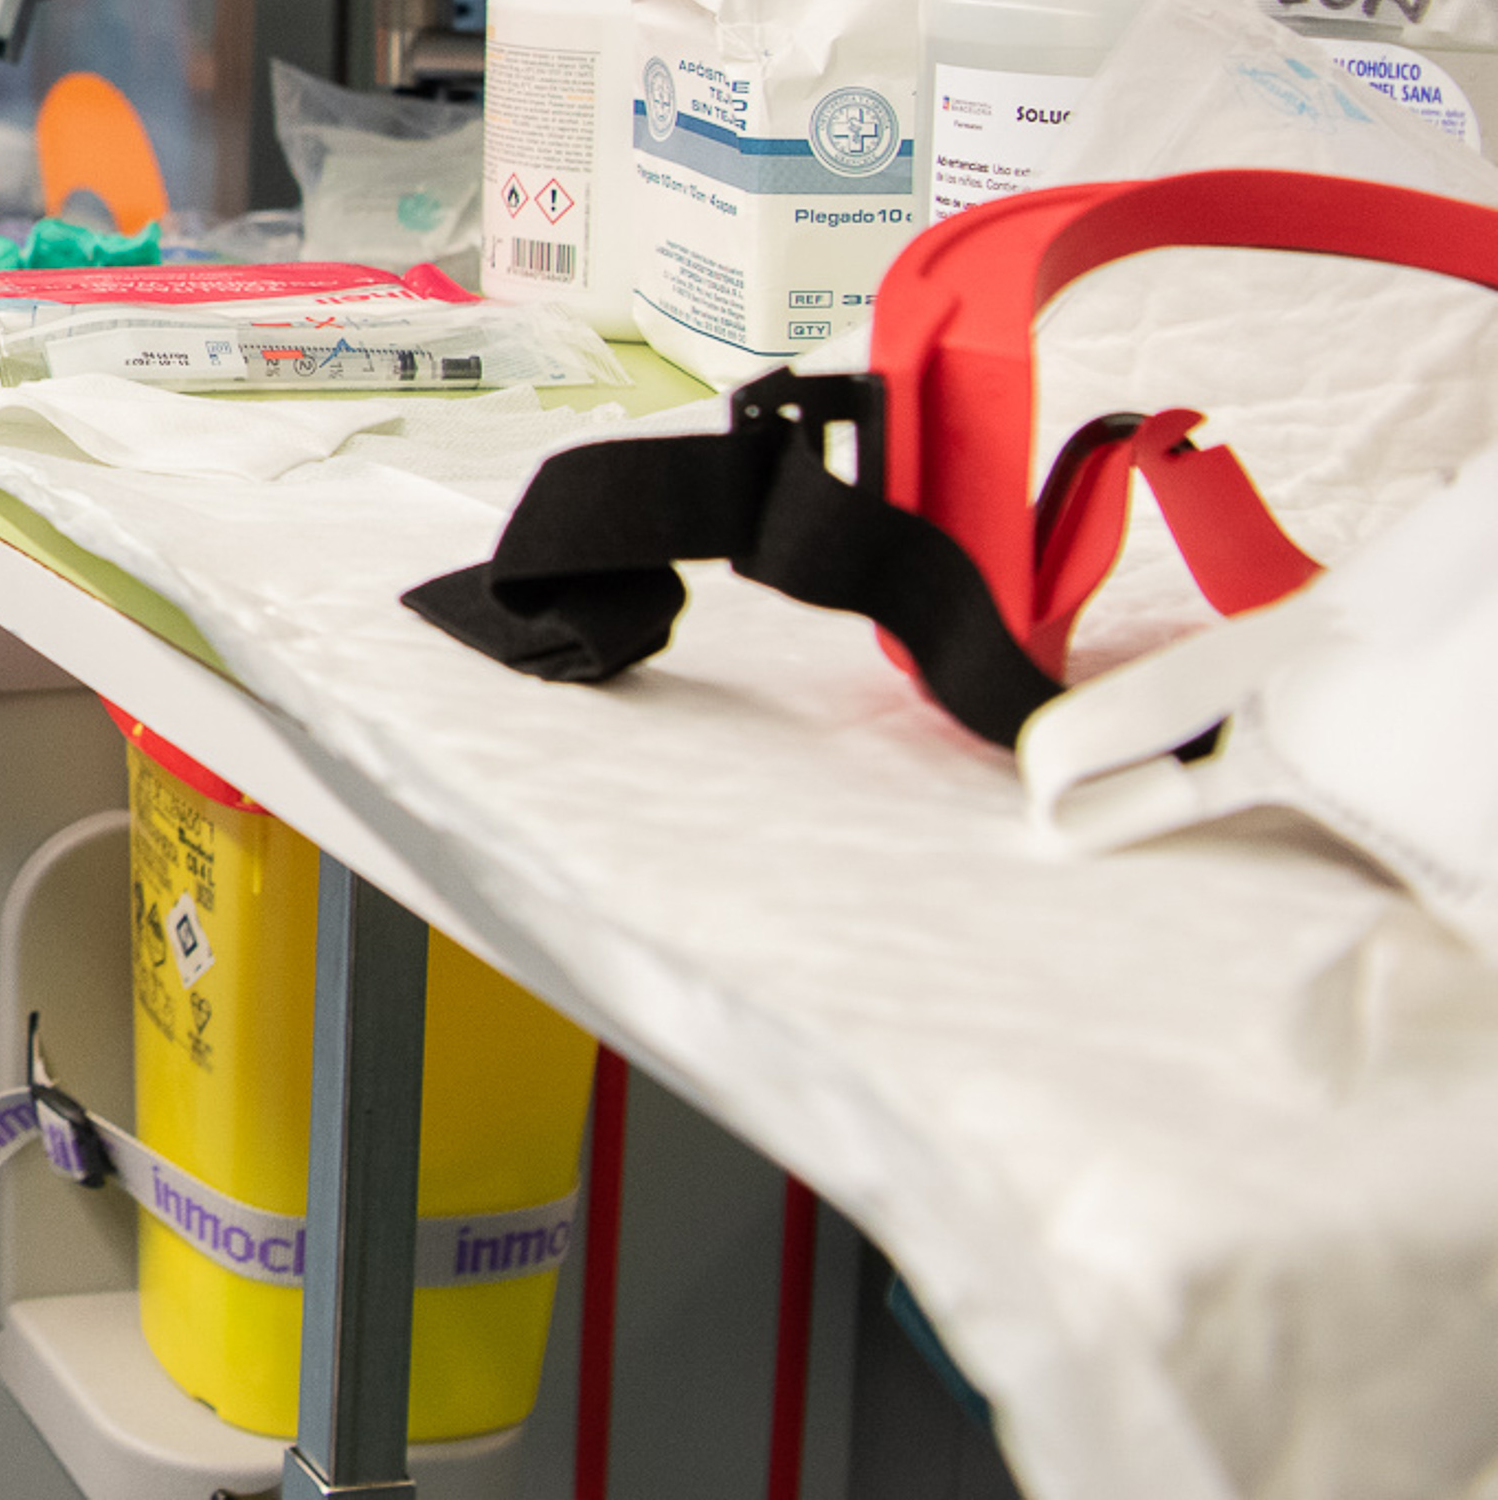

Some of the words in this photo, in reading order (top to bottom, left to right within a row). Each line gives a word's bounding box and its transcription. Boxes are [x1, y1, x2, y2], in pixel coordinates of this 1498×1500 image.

[1333, 55, 1422, 82] COHÓLICO
[1401, 83, 1444, 105] SANA
[691, 99, 713, 116] SIN
[794, 209, 875, 228] Plegado
[877, 209, 903, 223] 10
[794, 294, 825, 305] REF
[792, 325, 826, 336] QTY
